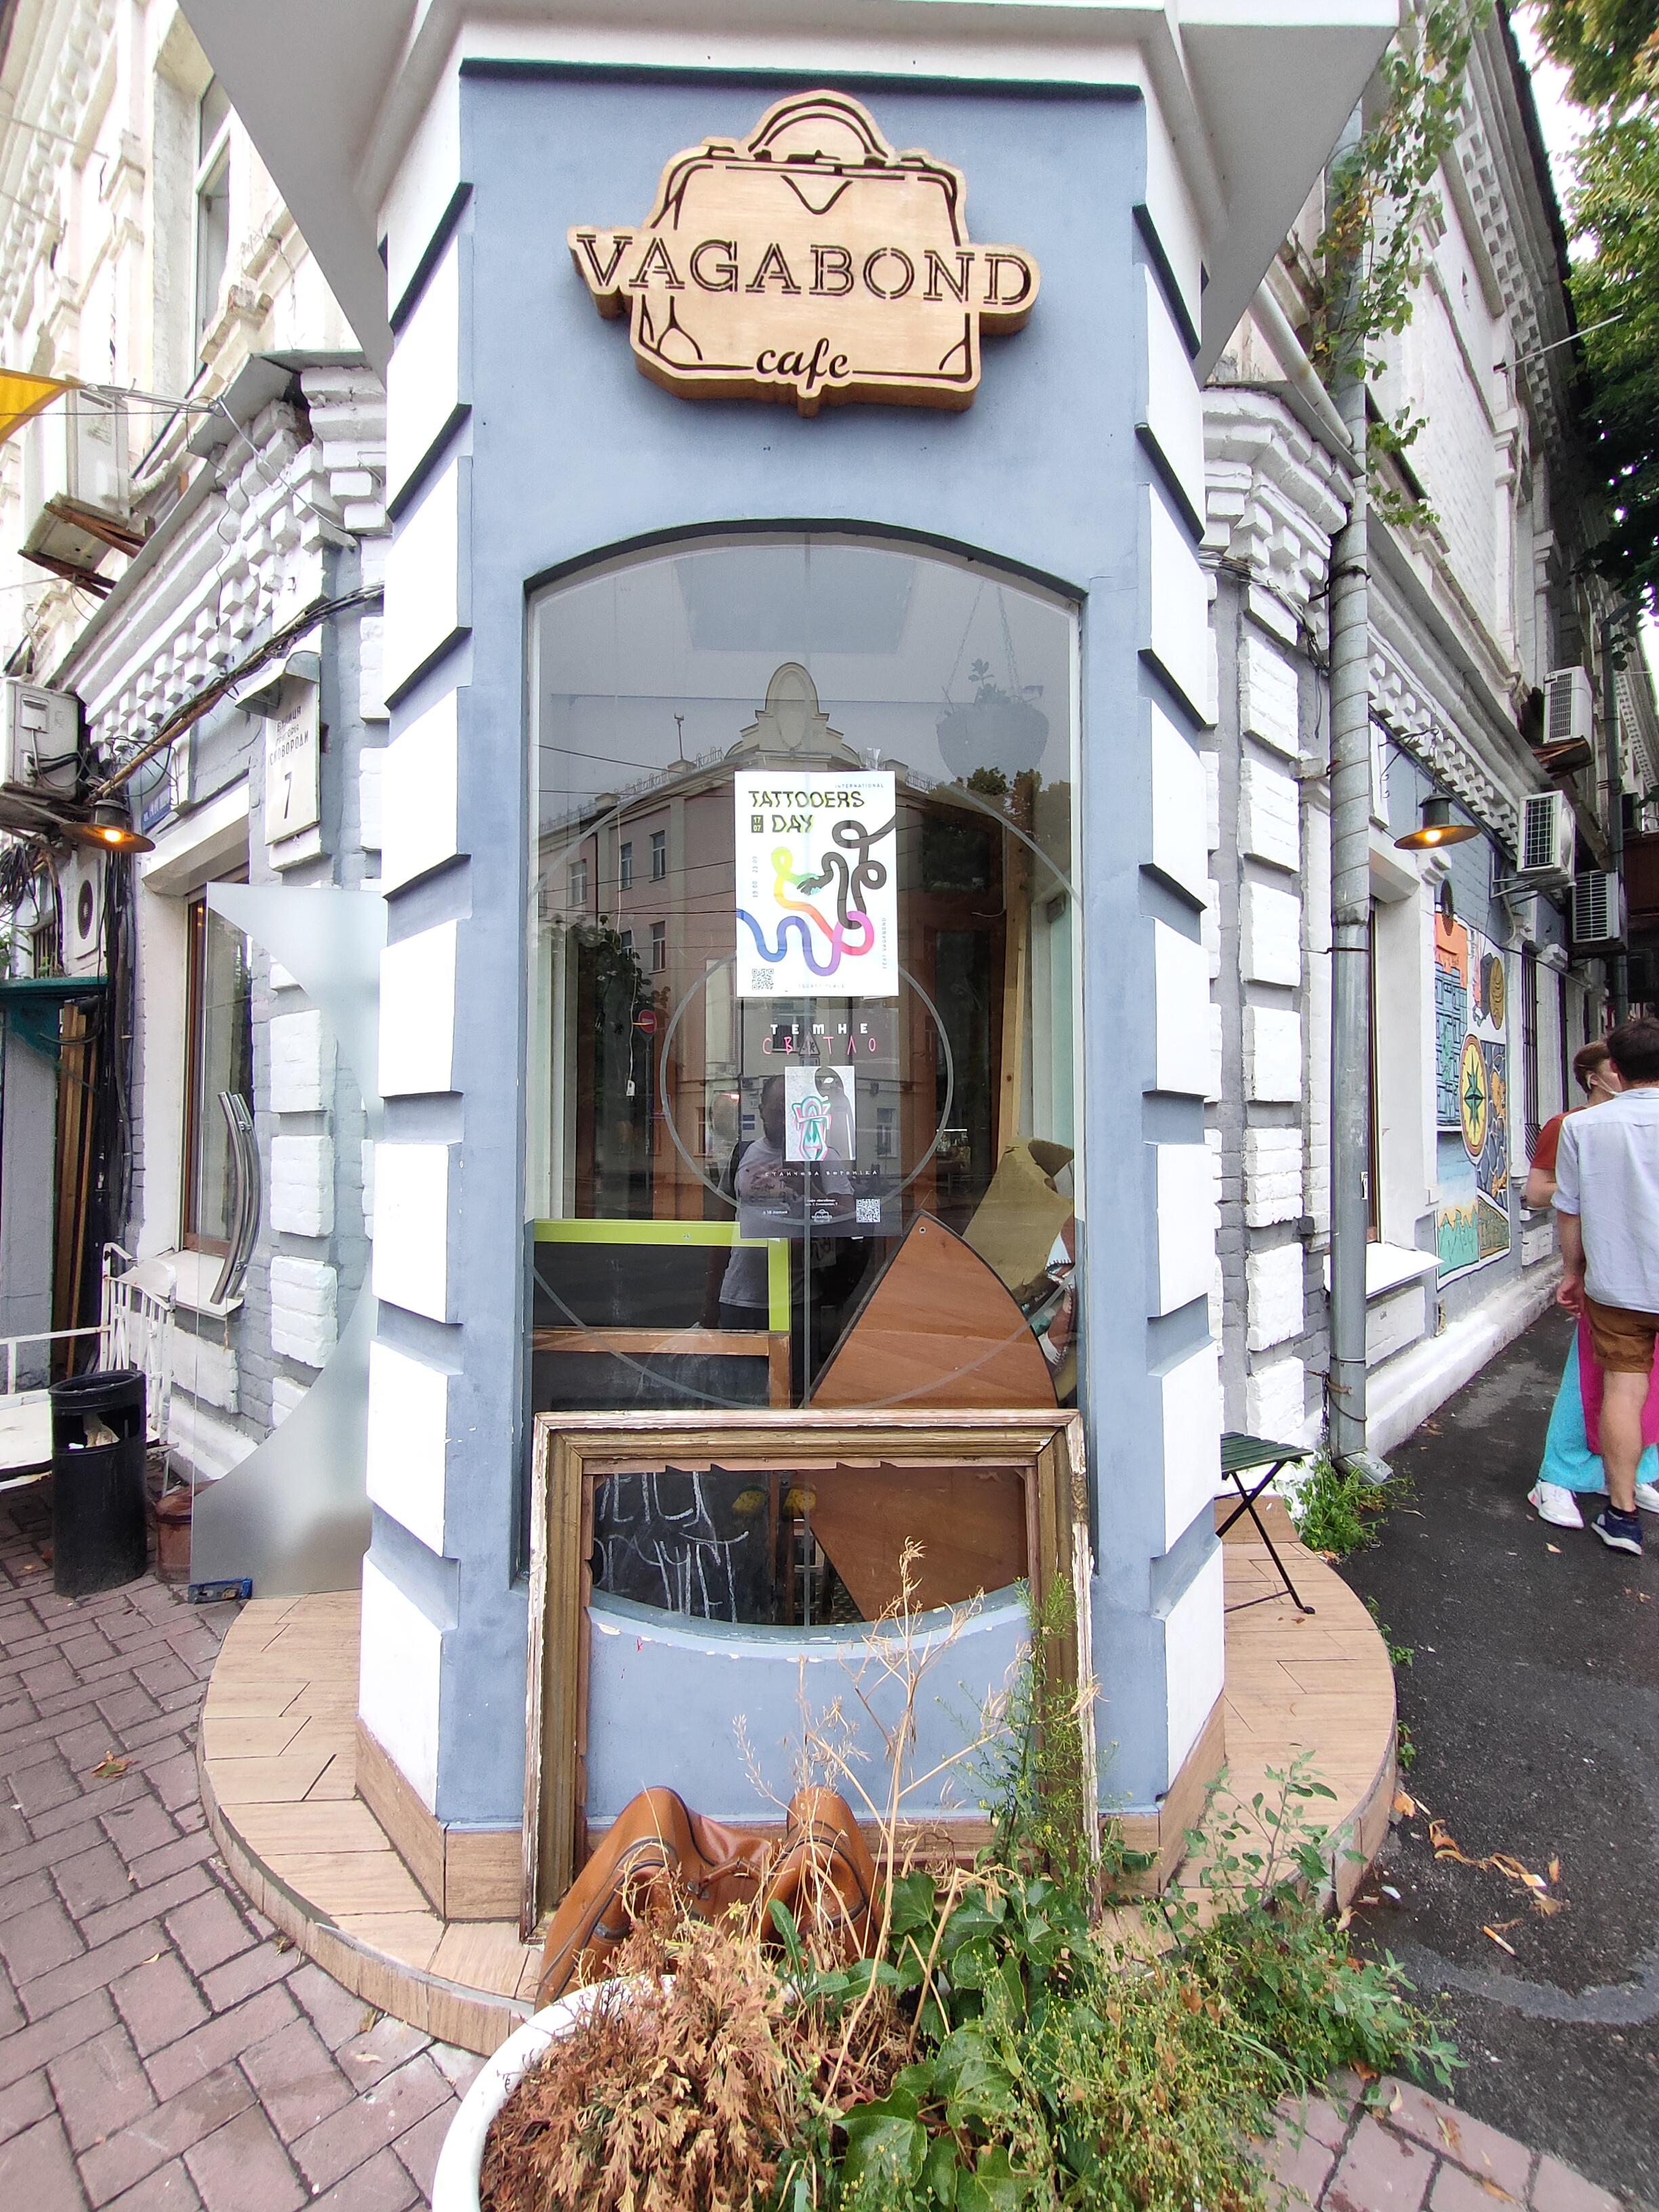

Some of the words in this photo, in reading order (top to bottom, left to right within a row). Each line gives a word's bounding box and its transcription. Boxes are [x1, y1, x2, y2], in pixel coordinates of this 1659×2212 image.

[576, 233, 1032, 306] VAGABOND
[756, 337, 851, 390] cafe
[269, 730, 309, 766] СКОВОРОДИ
[284, 771, 293, 819] 7
[748, 790, 865, 808] TATTOOERS
[772, 815, 813, 833] DAY
[771, 1023, 868, 1036] ТЕМНЕ
